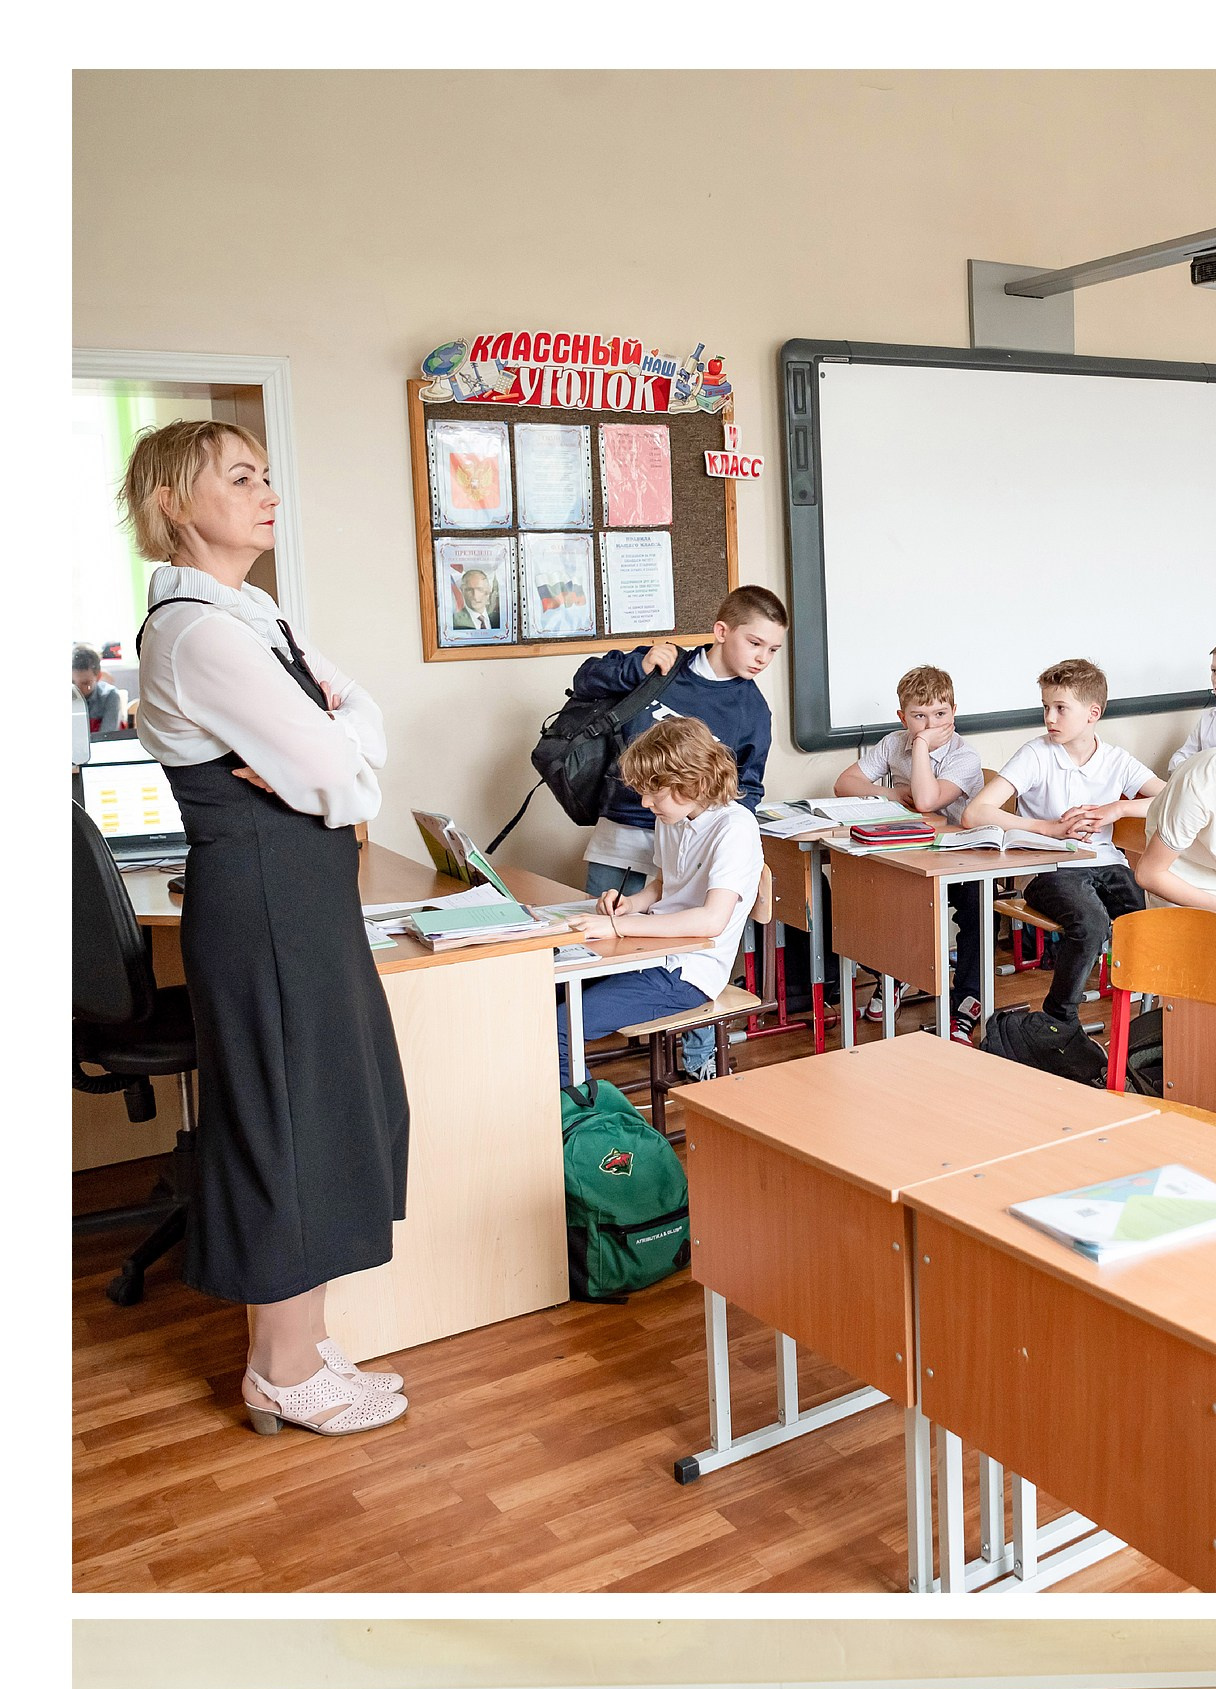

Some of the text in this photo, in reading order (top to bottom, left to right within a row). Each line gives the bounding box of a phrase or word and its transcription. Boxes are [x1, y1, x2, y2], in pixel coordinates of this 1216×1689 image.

[470, 332, 642, 367] КЛАССНЫЙ
[643, 357, 677, 378] НАШ
[519, 366, 658, 411] УГОЛОК
[708, 452, 763, 478] КЛАСС
